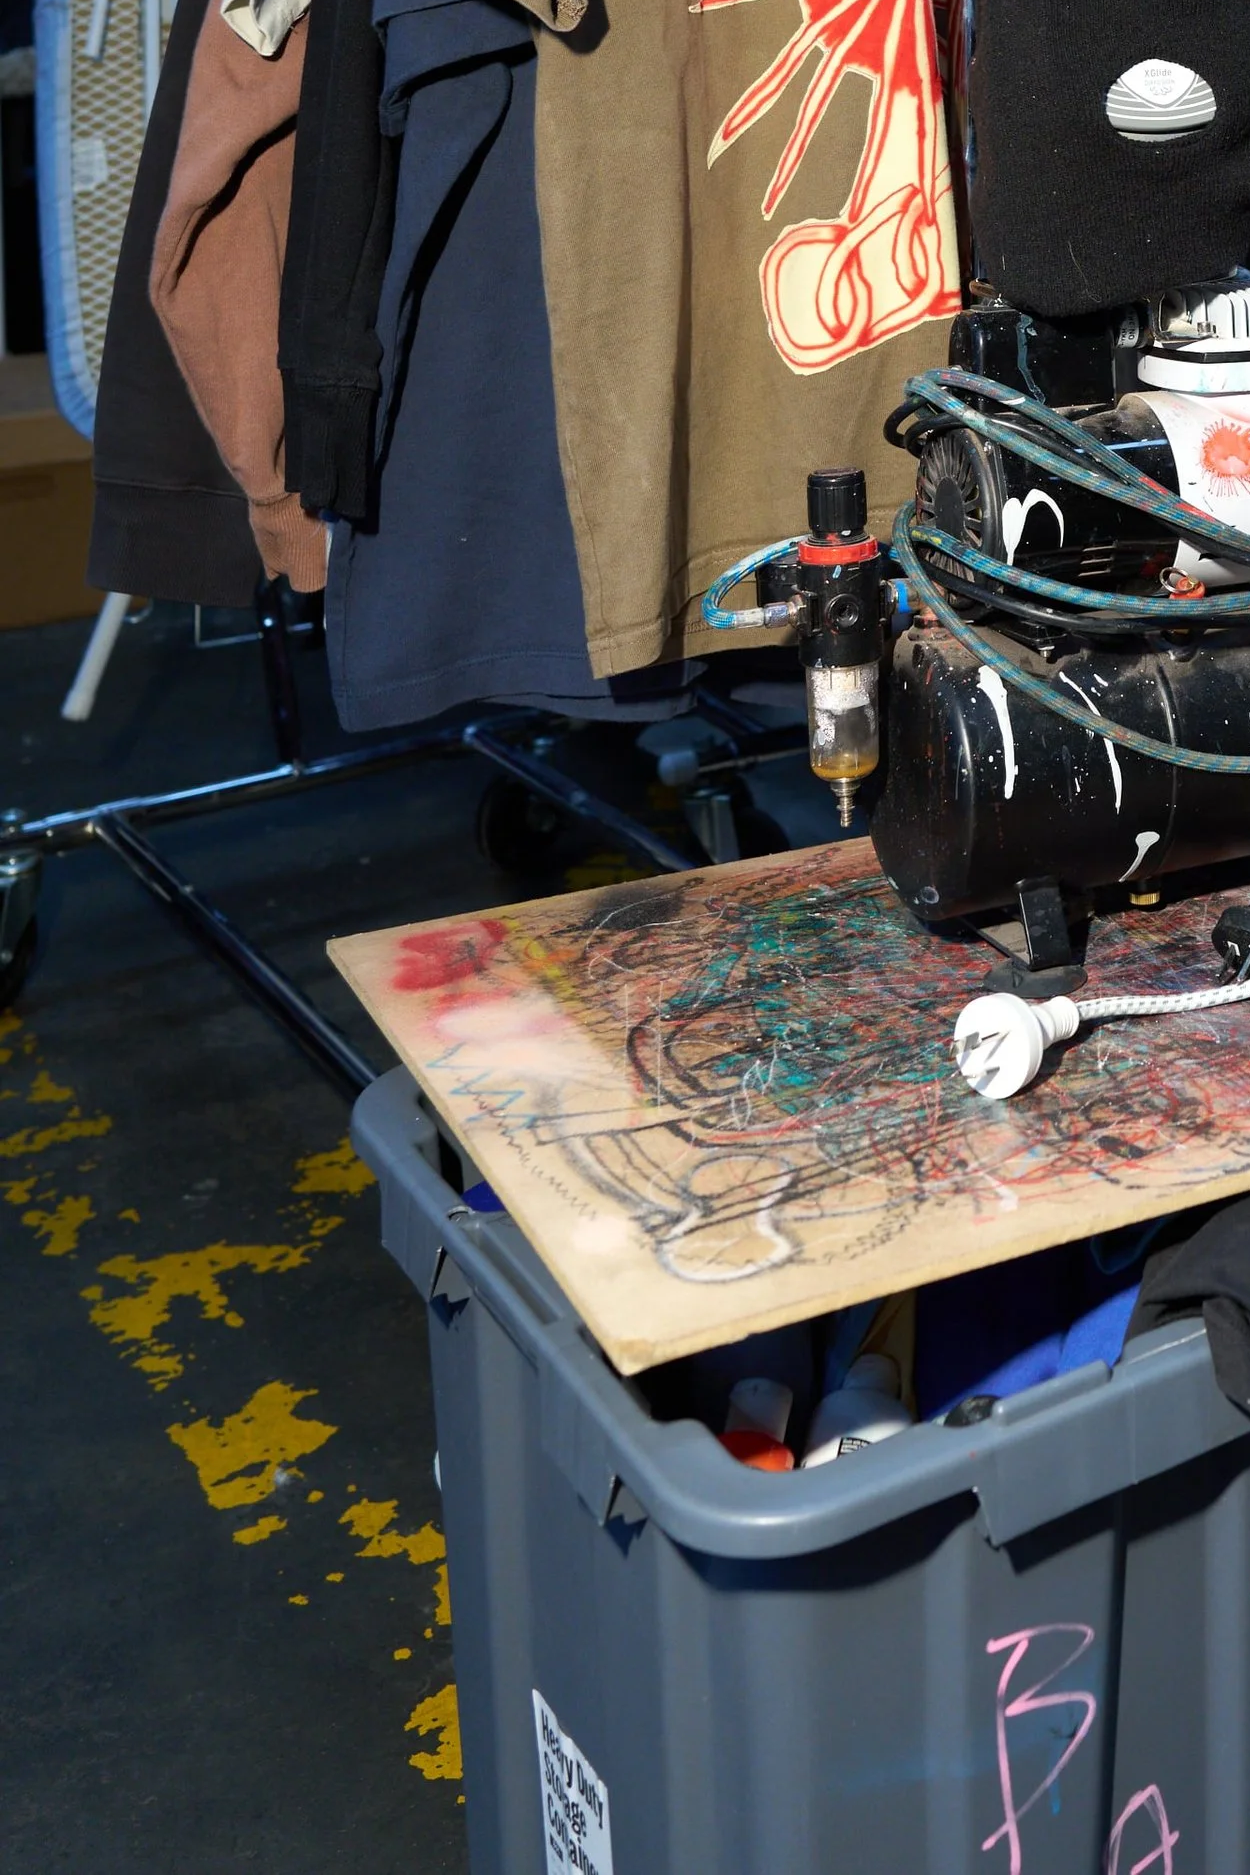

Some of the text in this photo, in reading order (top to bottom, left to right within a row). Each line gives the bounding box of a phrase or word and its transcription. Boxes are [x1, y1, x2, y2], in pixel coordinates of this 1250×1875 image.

[543, 1750, 588, 1839] Stoage
[548, 1794, 601, 1875] Conain
[576, 1758, 605, 1830] Duty
